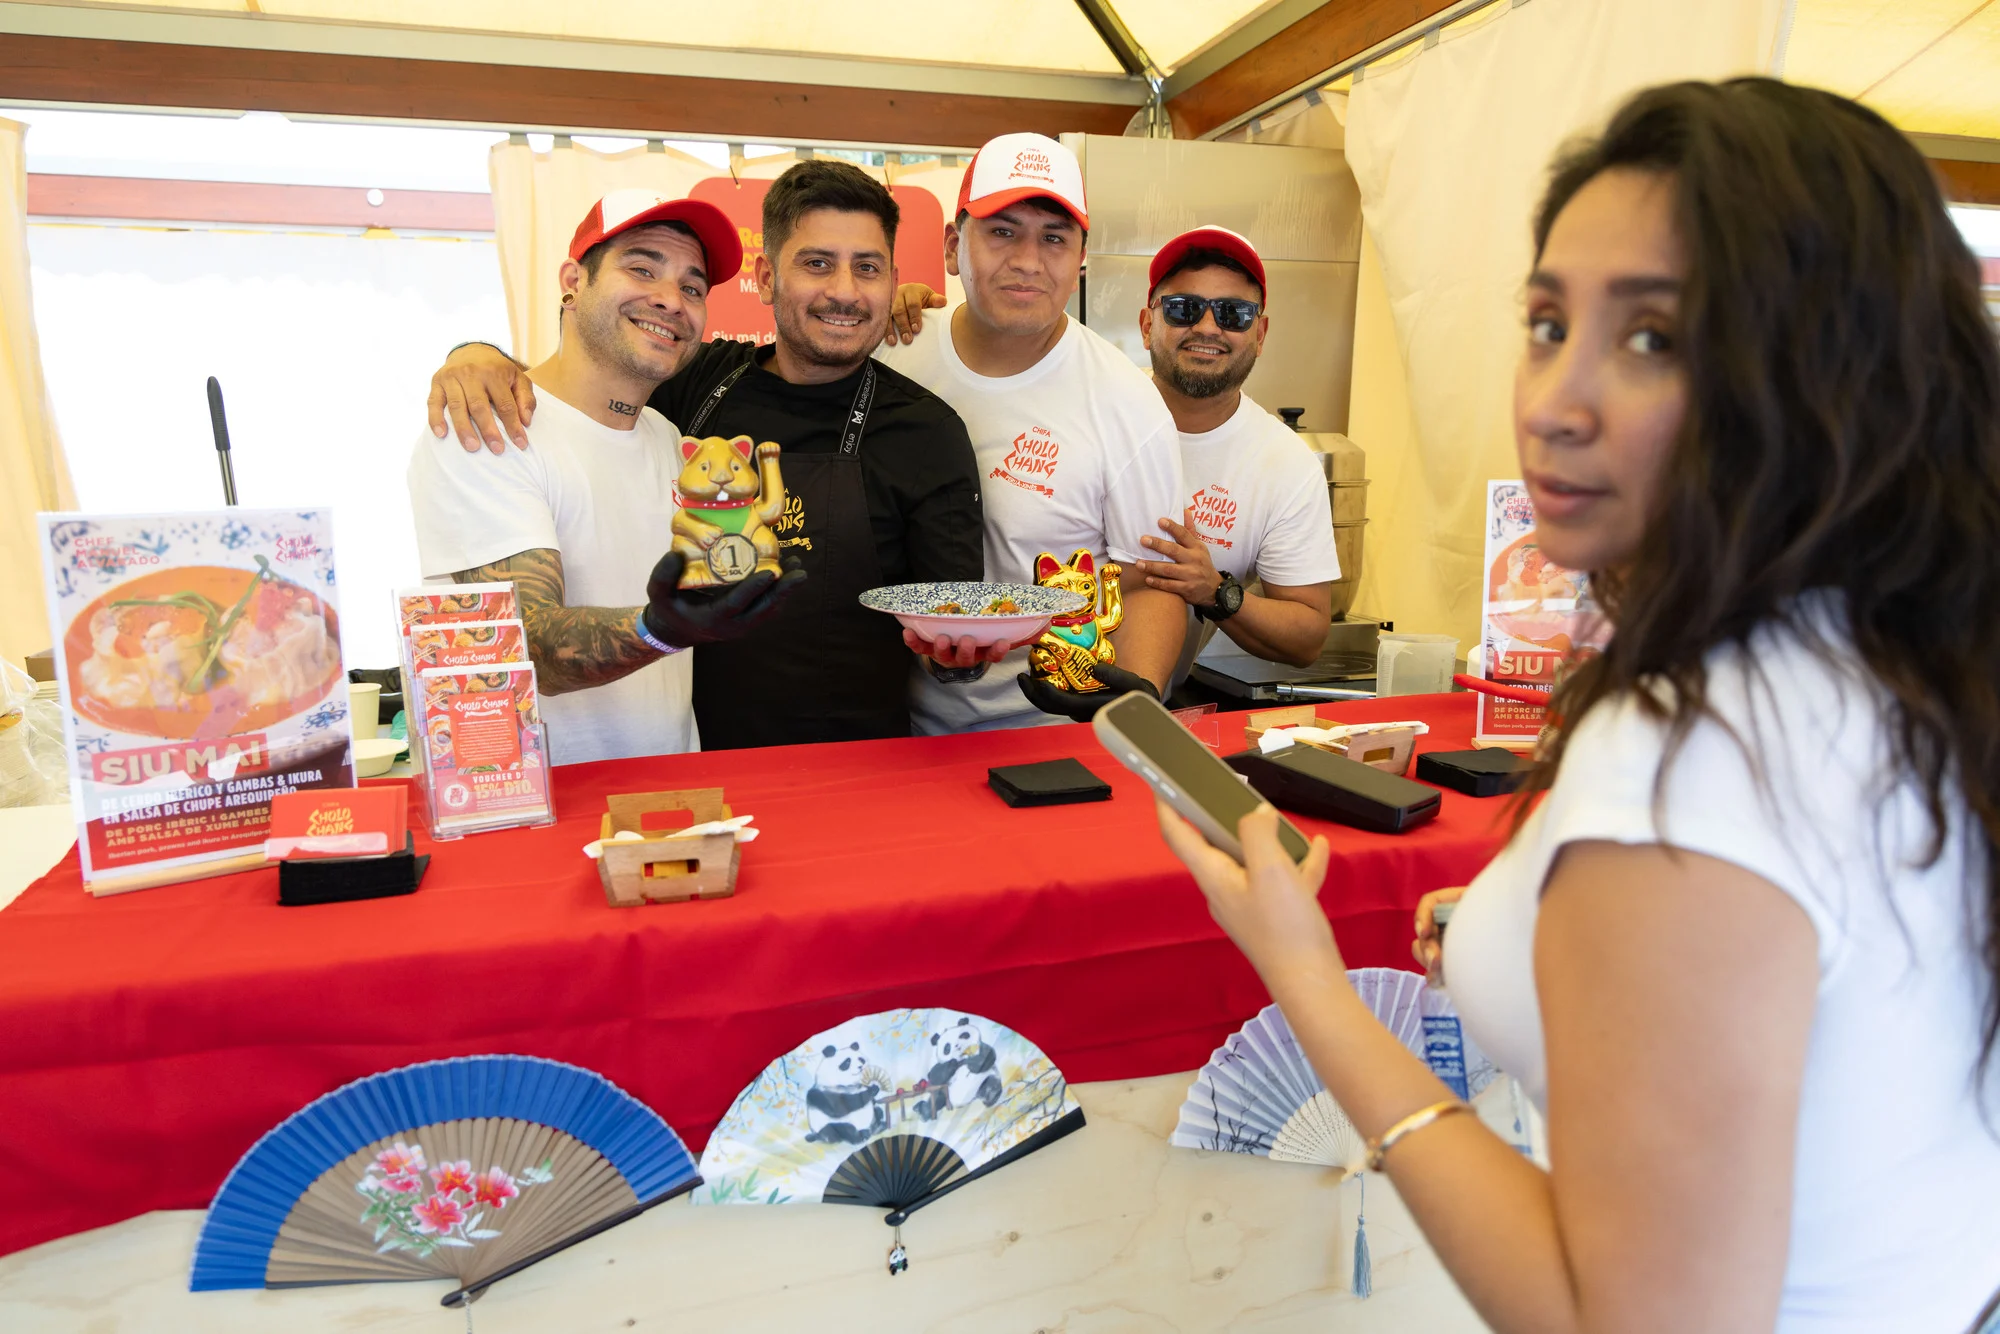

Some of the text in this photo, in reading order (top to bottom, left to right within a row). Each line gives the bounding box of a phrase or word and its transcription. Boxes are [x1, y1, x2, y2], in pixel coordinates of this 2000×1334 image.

[1016, 152, 1048, 164] CHOLO
[1014, 162, 1051, 174] CHANG
[711, 331, 734, 342] Siu
[736, 331, 760, 345] mai
[608, 399, 638, 416] 1923
[1032, 426, 1051, 438] CHIFA
[844, 433, 856, 454] enjoy
[1013, 432, 1059, 460] CHOLO
[1004, 450, 1058, 480] CHANG
[1210, 484, 1229, 496] CHIFA
[1192, 489, 1236, 516] CHOLO
[74, 536, 114, 547] CHEF
[76, 546, 140, 558] MANUEL
[726, 544, 740, 568] 1
[77, 555, 160, 568] ALVARADO
[443, 652, 496, 665] CHOLO CHANG
[1498, 656, 1544, 675] SIU
[454, 698, 509, 712] CHOLO CHANG
[100, 740, 262, 785] SIU MAI
[472, 772, 513, 784] VOUCHER
[102, 798, 118, 810] DE
[120, 792, 162, 808] CERDO
[216, 782, 224, 794] Y
[226, 776, 275, 793] GAMBAS
[278, 774, 286, 786] &
[288, 769, 322, 785] IKURA
[474, 779, 536, 799] 15% DTO.
[102, 813, 120, 825] EN
[124, 805, 162, 822] SALSA
[164, 802, 180, 816] DE
[183, 796, 222, 813] CHUPE
[308, 808, 351, 826] CHOLO
[106, 828, 123, 838] DE
[128, 822, 162, 835] PORC
[166, 816, 208, 829] IBÈRIC
[220, 806, 270, 820] GAMBES
[306, 818, 354, 838] CHANG
[107, 836, 136, 848] AMB
[140, 829, 180, 842] SALSA
[185, 826, 202, 836] DE
[206, 820, 239, 832] XUME
[108, 848, 136, 858] Iberian
[159, 843, 186, 852] prawns
